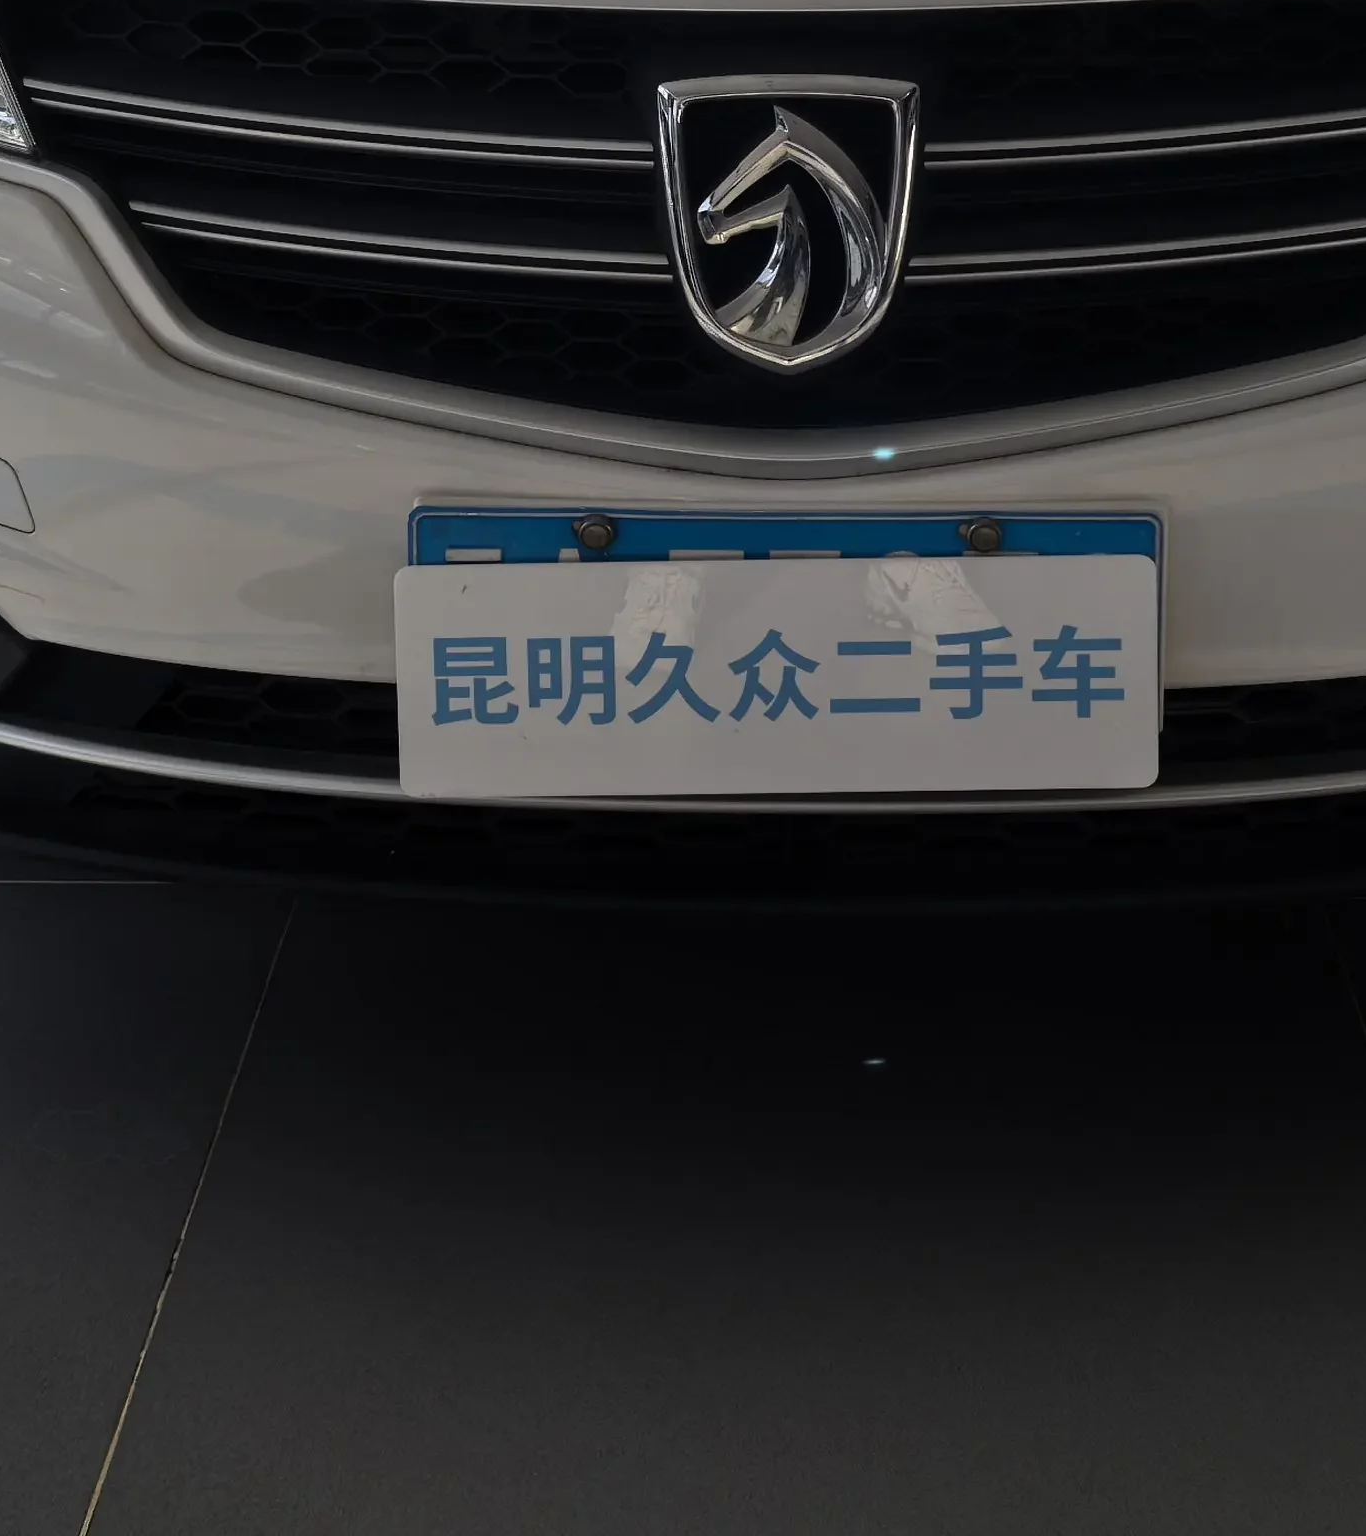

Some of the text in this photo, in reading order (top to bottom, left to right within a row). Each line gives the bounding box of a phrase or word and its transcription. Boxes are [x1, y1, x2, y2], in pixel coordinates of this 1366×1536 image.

[431, 625, 1126, 726] 昆明久众二手车
